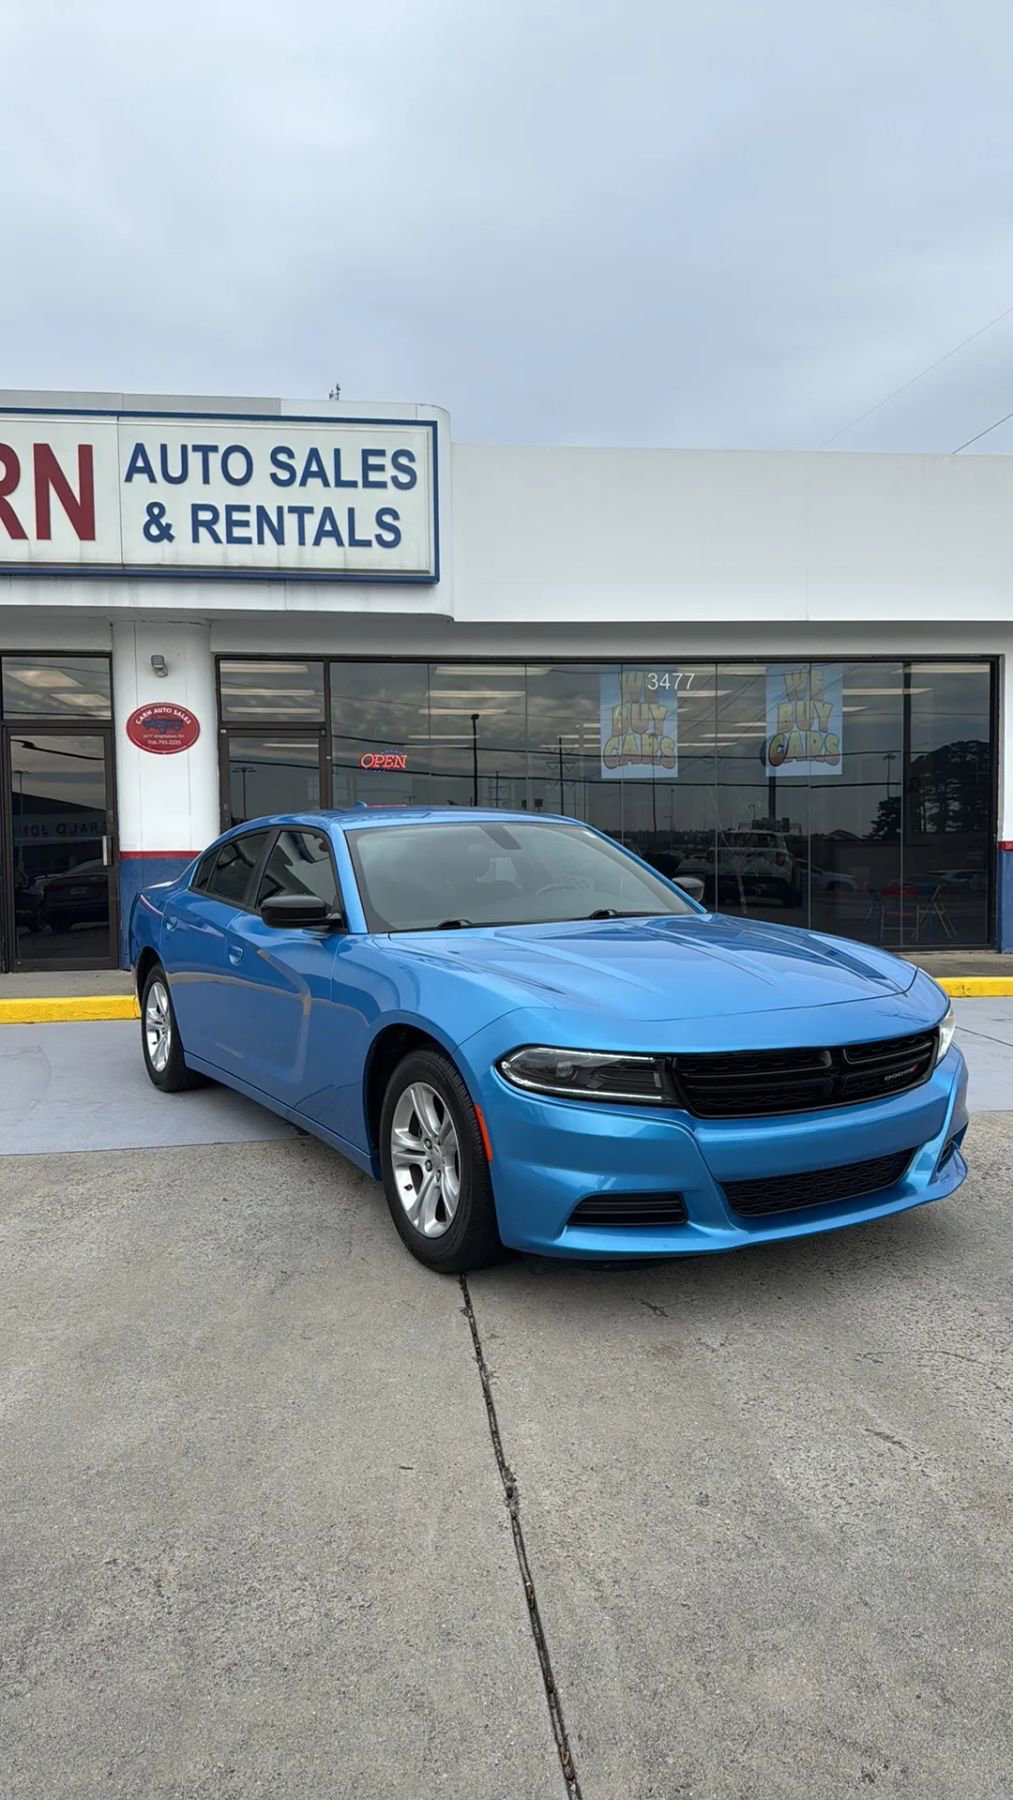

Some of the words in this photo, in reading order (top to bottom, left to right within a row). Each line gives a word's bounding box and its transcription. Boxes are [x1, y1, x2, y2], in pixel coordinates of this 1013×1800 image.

[124, 443, 254, 486] AUTO
[269, 446, 418, 490] SALES
[143, 501, 176, 543] &
[190, 503, 401, 549] RENTALS
[647, 672, 695, 690] 3477
[784, 670, 824, 702] WE
[173, 709, 191, 725] SALES
[611, 702, 668, 737] BUY
[777, 699, 833, 734] BUY
[360, 753, 408, 769] OPEN
[603, 733, 676, 769] CARS
[768, 731, 841, 767] CARS
